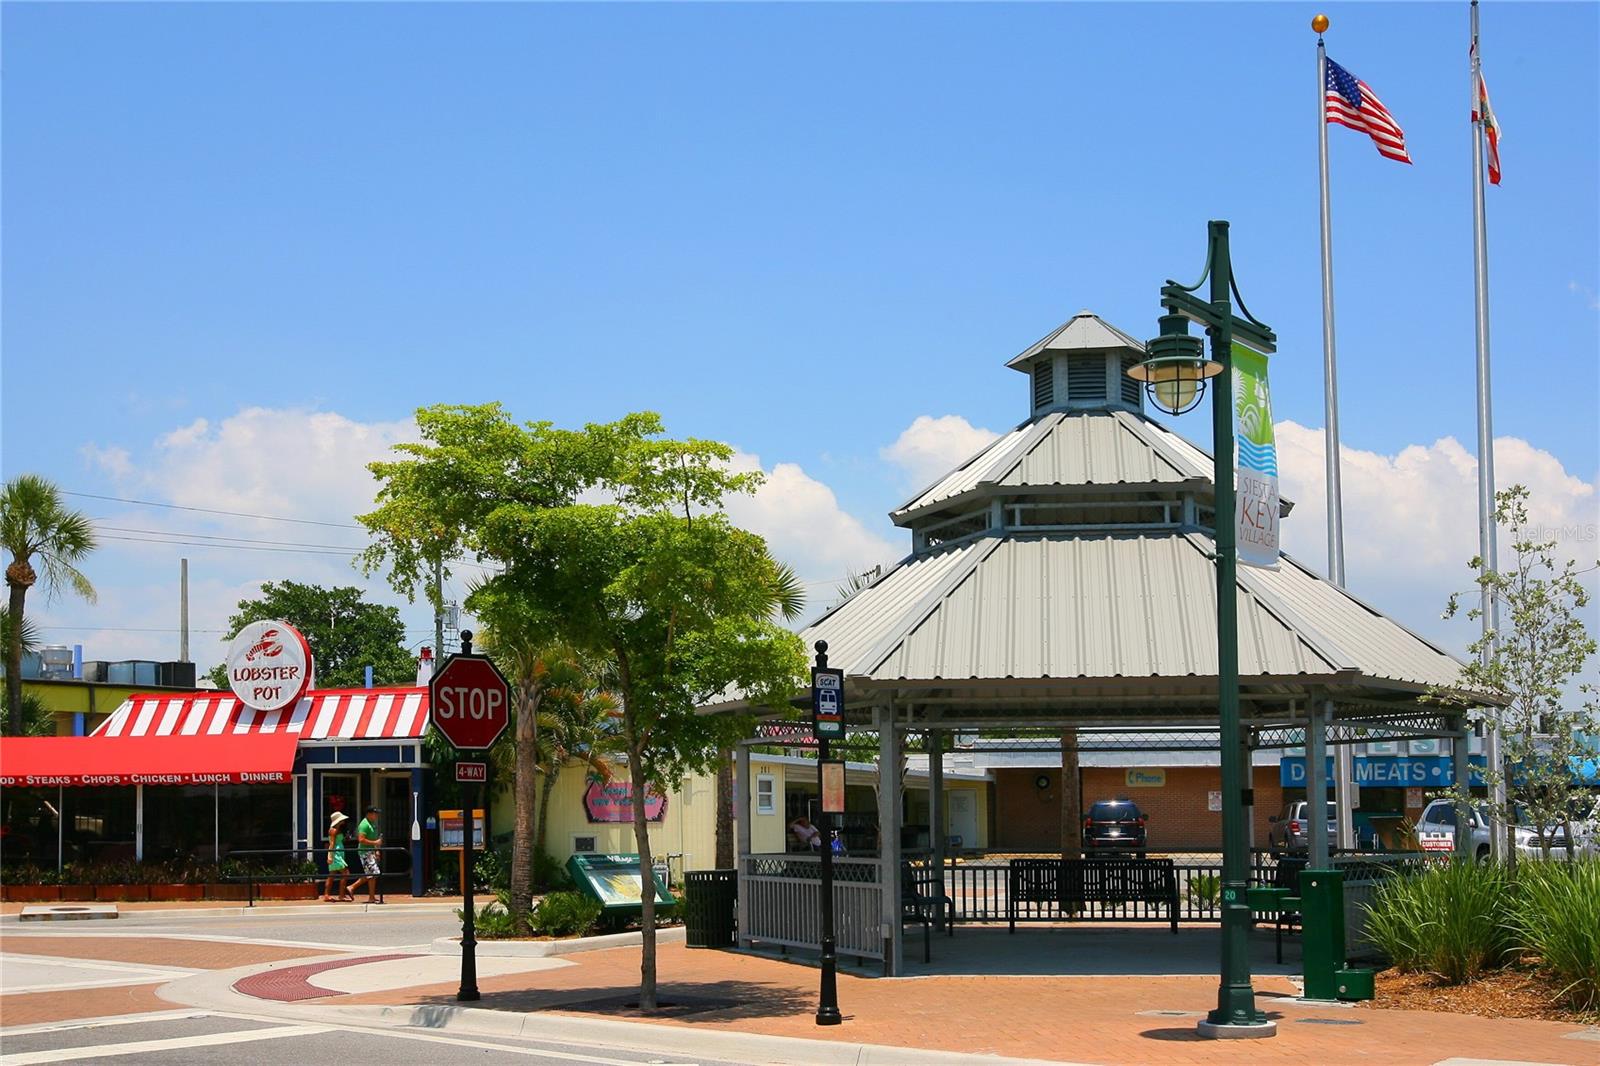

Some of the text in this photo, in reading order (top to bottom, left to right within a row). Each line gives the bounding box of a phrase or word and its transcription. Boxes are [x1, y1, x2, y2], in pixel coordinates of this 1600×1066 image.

[1243, 477, 1275, 499] SIESTA
[1241, 497, 1277, 531] KEY
[1239, 527, 1276, 548] VILLAGE
[234, 666, 300, 681] LOBSTER
[820, 678, 836, 687] SCAT
[254, 686, 282, 700] POT
[440, 686, 502, 720] STOP
[459, 766, 484, 778] 4-WAY
[1356, 762, 1427, 781] MEATS
[1225, 890, 1236, 900] 20
